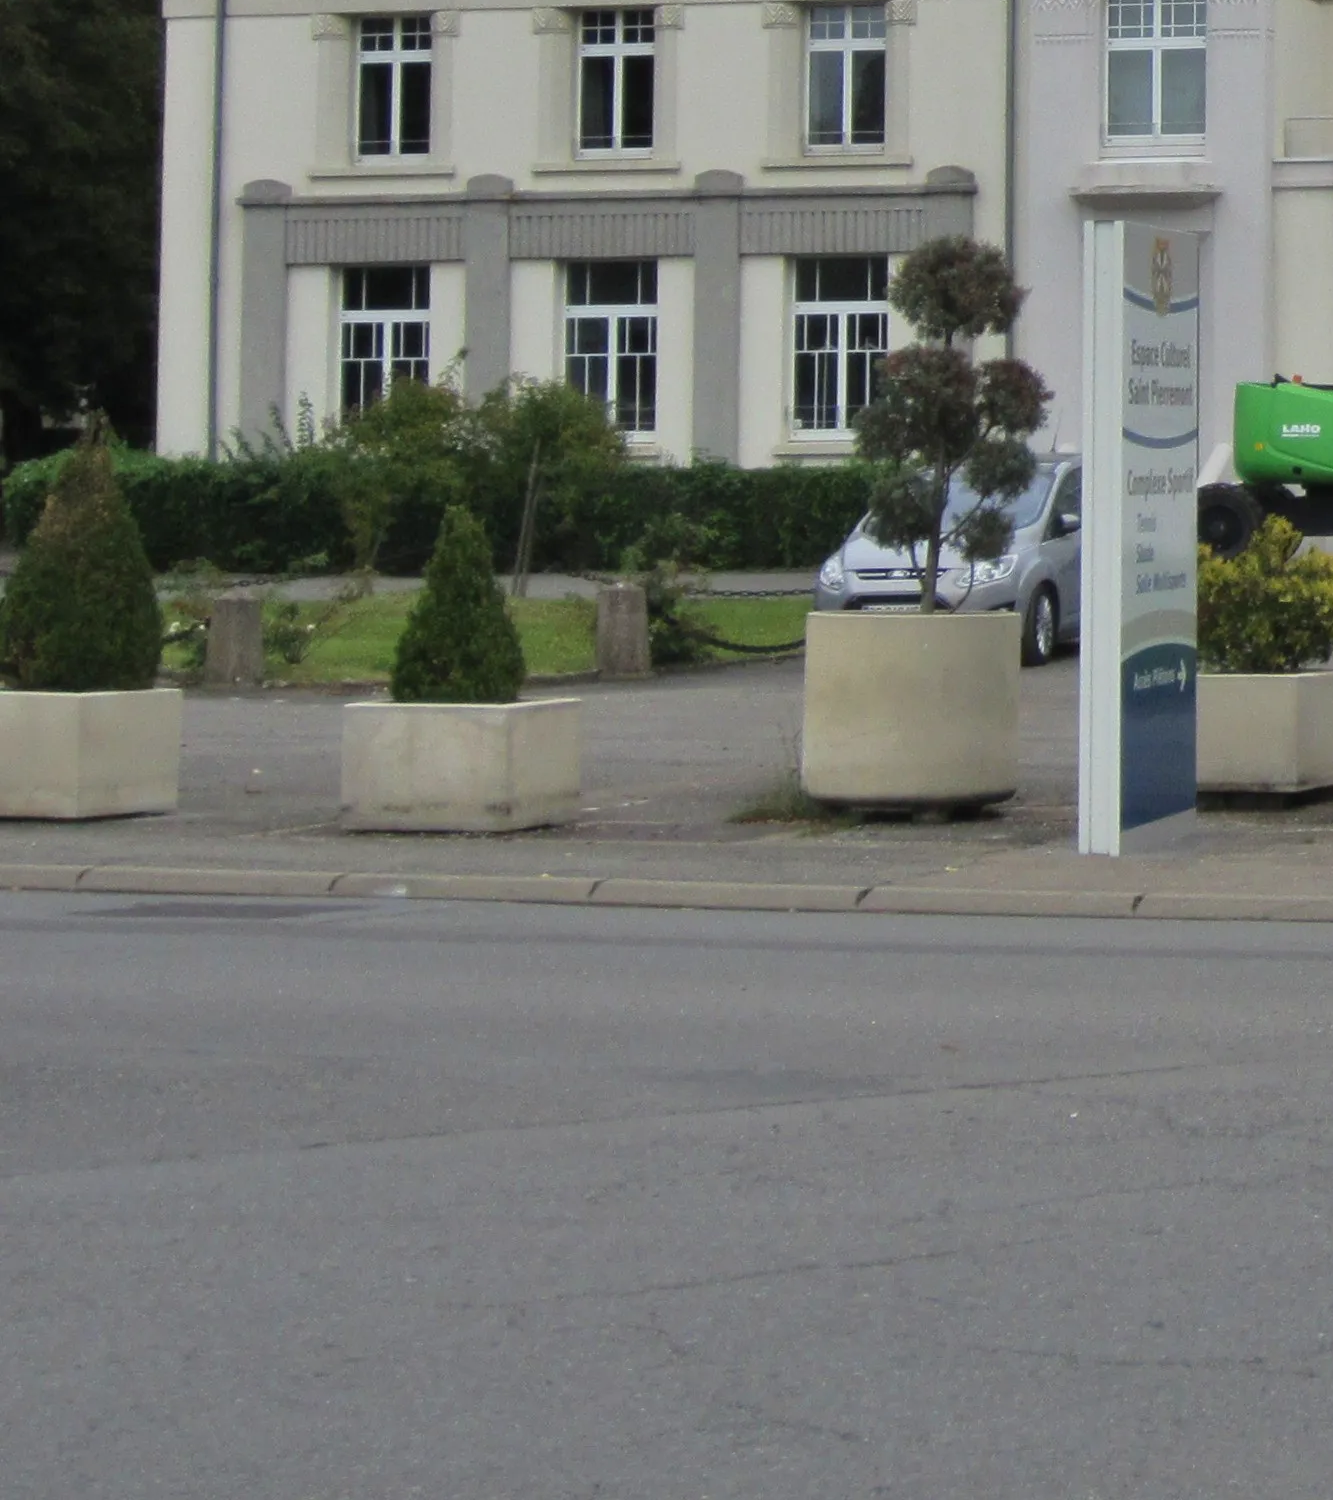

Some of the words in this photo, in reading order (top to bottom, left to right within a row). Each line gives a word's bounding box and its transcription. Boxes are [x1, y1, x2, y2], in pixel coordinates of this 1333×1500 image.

[1131, 339, 1159, 372] Espace
[1161, 340, 1191, 369] Culturel
[1128, 377, 1149, 405] Saint
[1282, 423, 1321, 434] LAHO
[1127, 469, 1166, 502] Complexe
[1168, 466, 1193, 501] Sportif
